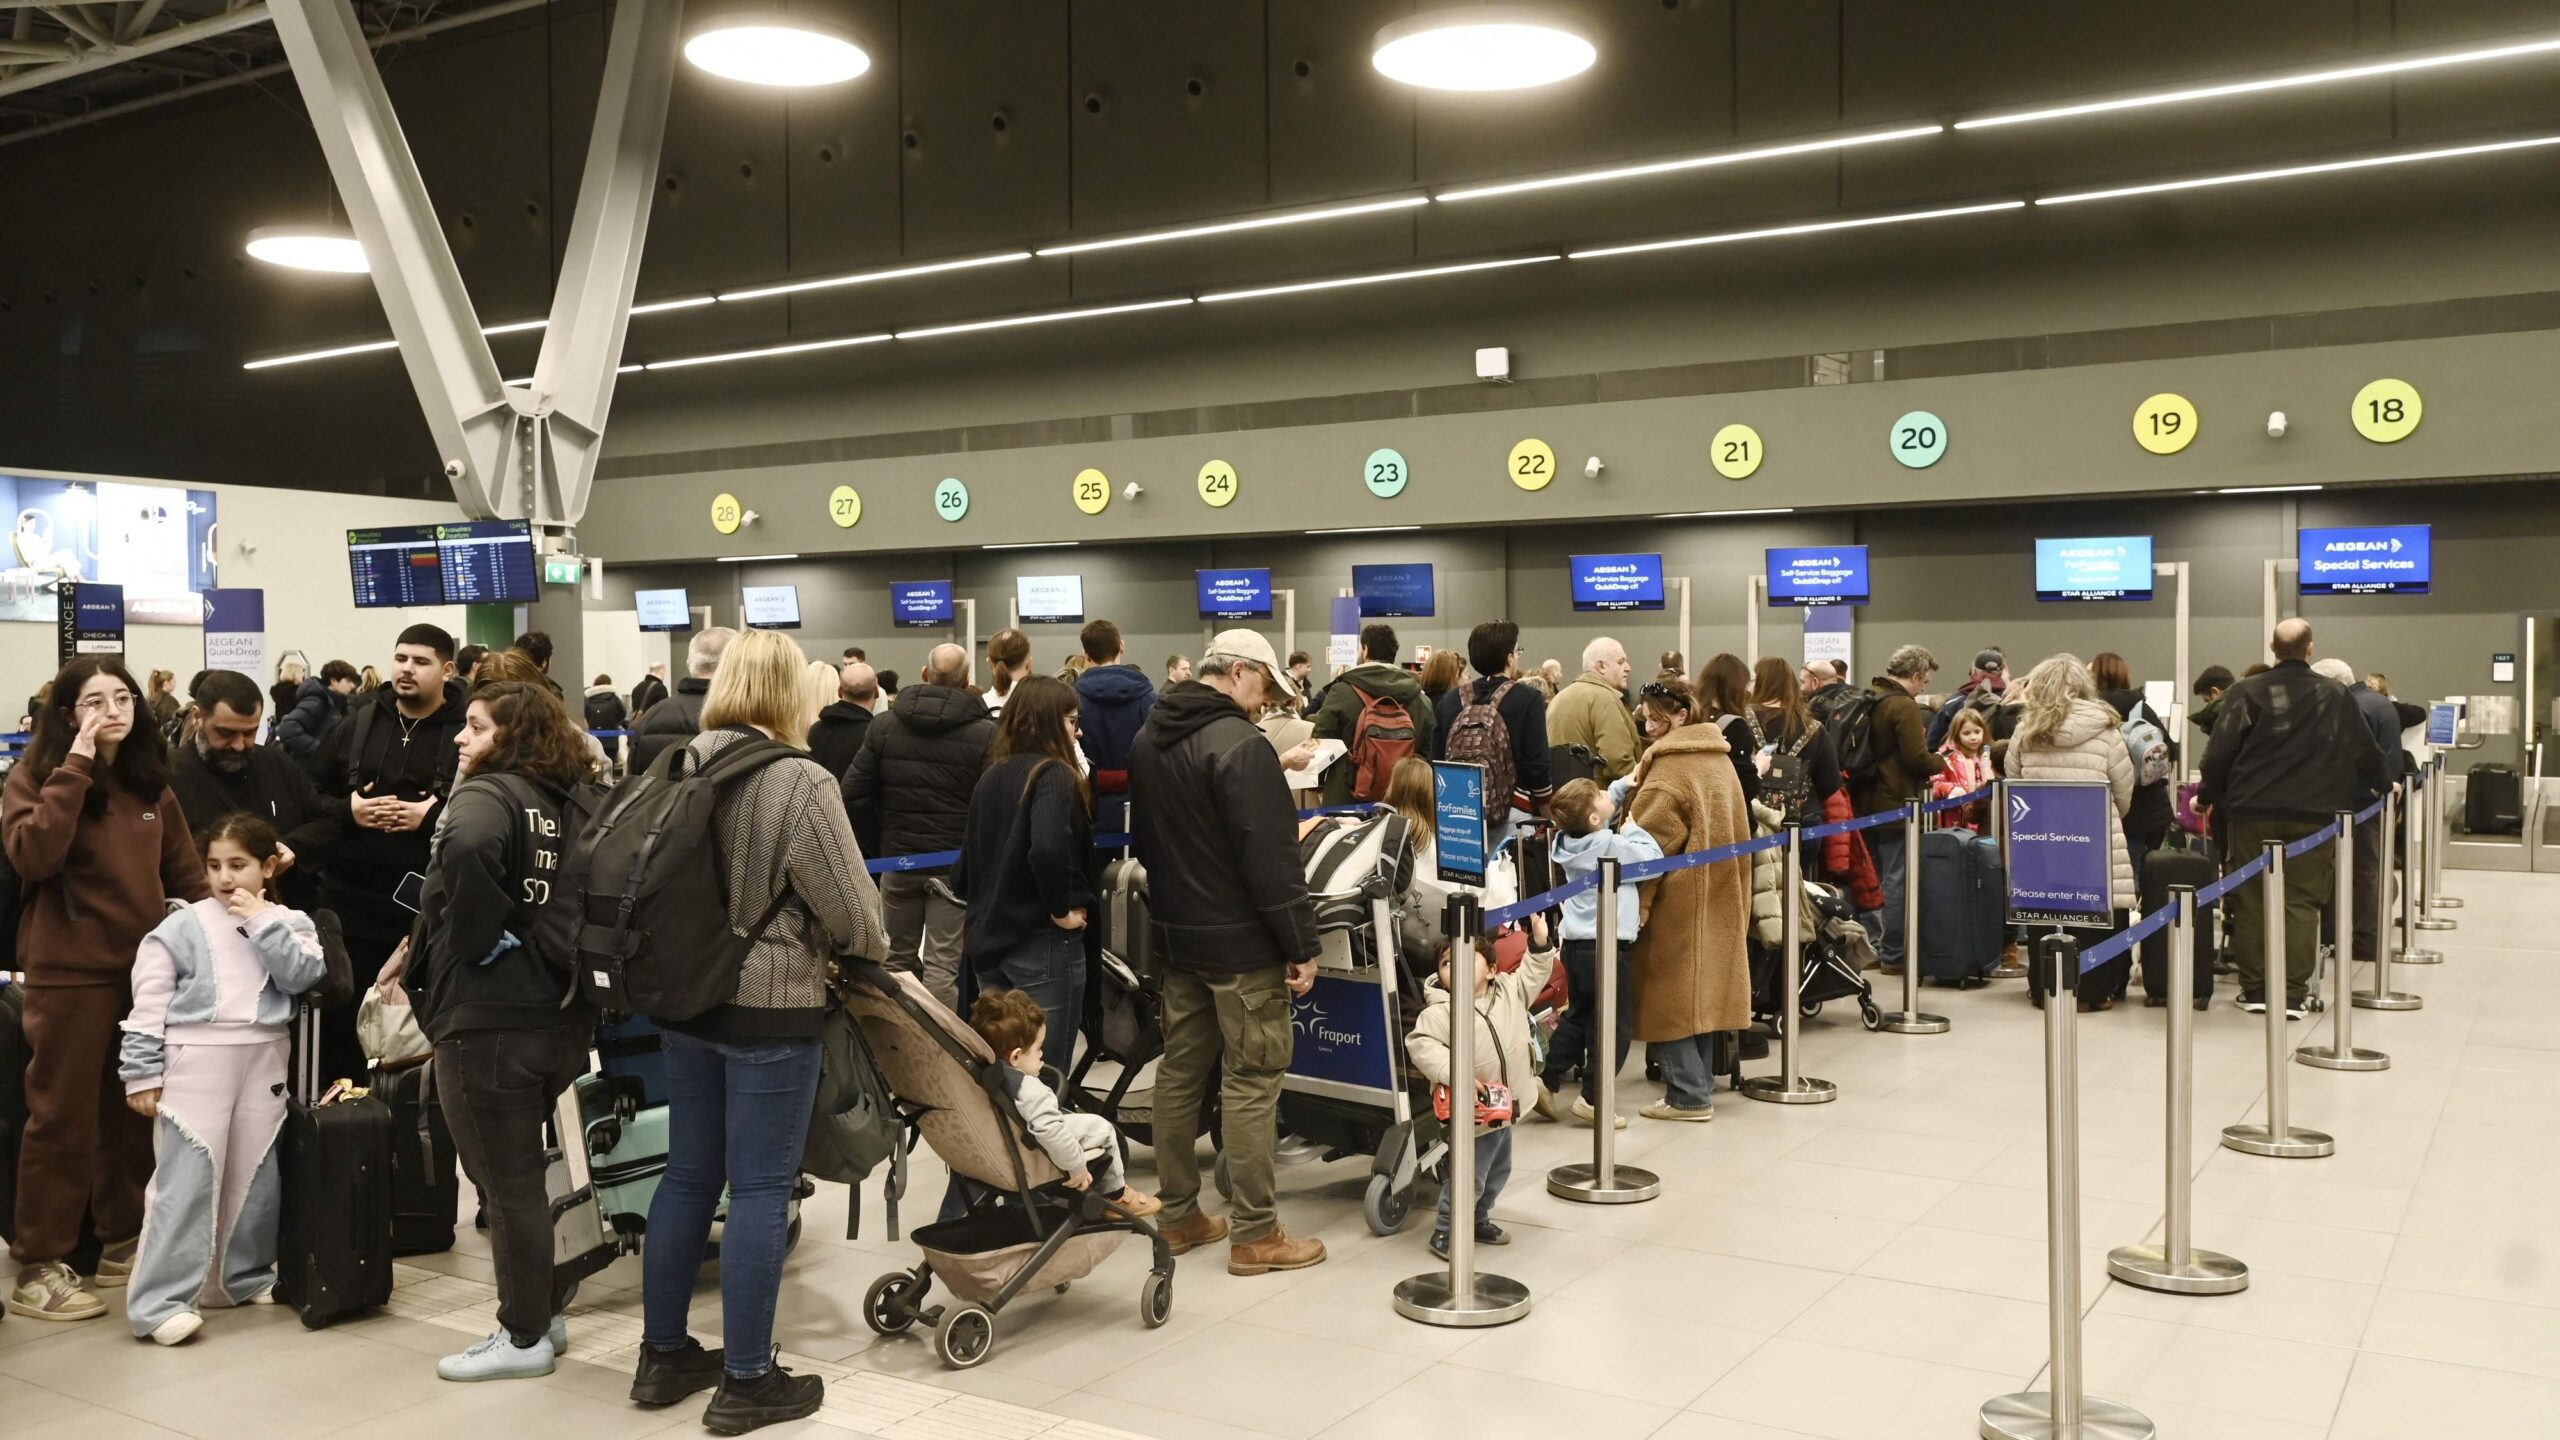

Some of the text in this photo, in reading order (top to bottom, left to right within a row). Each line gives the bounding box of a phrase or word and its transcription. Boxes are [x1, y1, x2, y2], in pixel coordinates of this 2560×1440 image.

[2369, 398, 2405, 424] 18
[2150, 412, 2181, 436] 19
[1901, 426, 1936, 450] 20
[1724, 440, 1749, 463] 21
[1518, 454, 1546, 475] 22
[1373, 463, 1399, 483] 23
[1080, 482, 1102, 500] 25
[1205, 474, 1230, 493] 24
[836, 499, 854, 515] 27
[941, 491, 962, 509] 26
[717, 506, 735, 522] 28
[2325, 541, 2388, 552] AEGEAN
[1593, 566, 1630, 574] AEGEAN
[1791, 559, 1832, 567] AEGEAN
[2313, 558, 2415, 573] Special Services
[63, 601, 75, 664] LLIANCE
[209, 637, 253, 646] AEGEAN
[208, 647, 262, 658] QuickDrop
[1437, 802, 1477, 816] ForFamilies
[525, 808, 556, 837] The
[2011, 831, 2091, 843] Special Services
[1440, 851, 1482, 864] Please enter here
[1455, 872, 1477, 882] ALLIANCE
[2013, 888, 2100, 901] Please enter here
[2015, 911, 2089, 922] STAR ALLIANCE
[1318, 1026, 1362, 1046] Fraport
